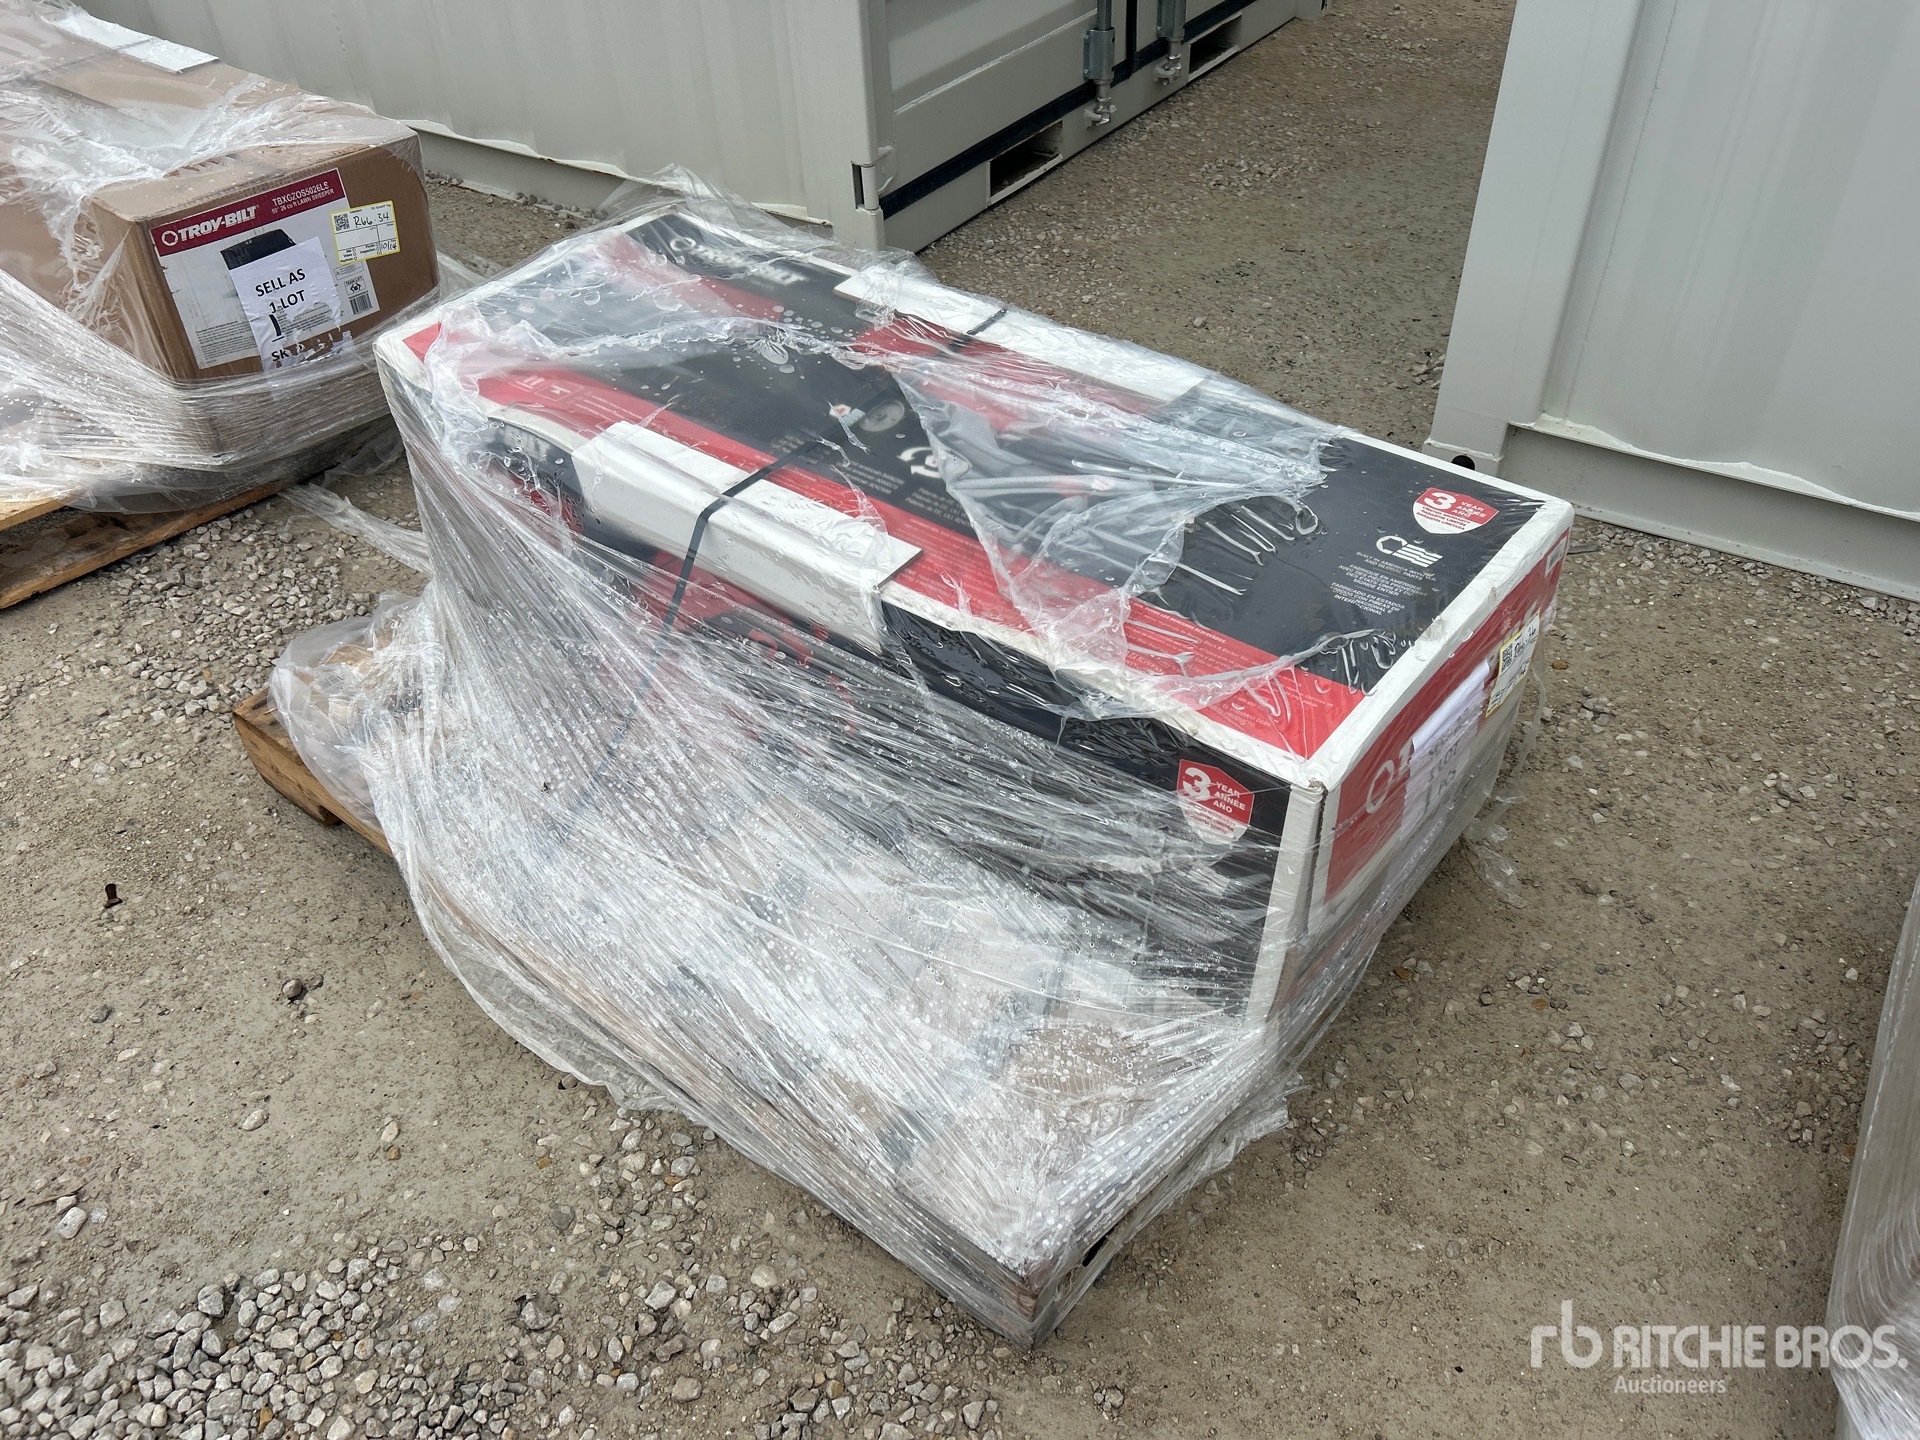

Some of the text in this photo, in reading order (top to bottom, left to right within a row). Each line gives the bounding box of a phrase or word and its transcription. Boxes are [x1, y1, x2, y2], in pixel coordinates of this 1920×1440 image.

[298, 198, 311, 206] LAWN
[312, 189, 334, 200] SWEEPER
[178, 206, 256, 242] TROY-BILT
[256, 269, 305, 297] SELL AS
[280, 290, 305, 308] LOT
[1424, 492, 1456, 510] 3
[1461, 501, 1484, 511] YEAR
[1378, 563, 1401, 573] GLOBAL
[1403, 572, 1423, 580] PARTS
[1381, 560, 1408, 571] AMERICA
[1332, 582, 1367, 596] FABRICADO
[1376, 597, 1405, 609] ESTADOS
[1353, 579, 1400, 596] MONDE ENTIER
[1390, 582, 1428, 596] PROVENANT
[1183, 768, 1212, 800] 3
[1216, 782, 1240, 798] YEAR
[1213, 800, 1233, 813] AÑO
[1214, 791, 1246, 811] ANNÉE
